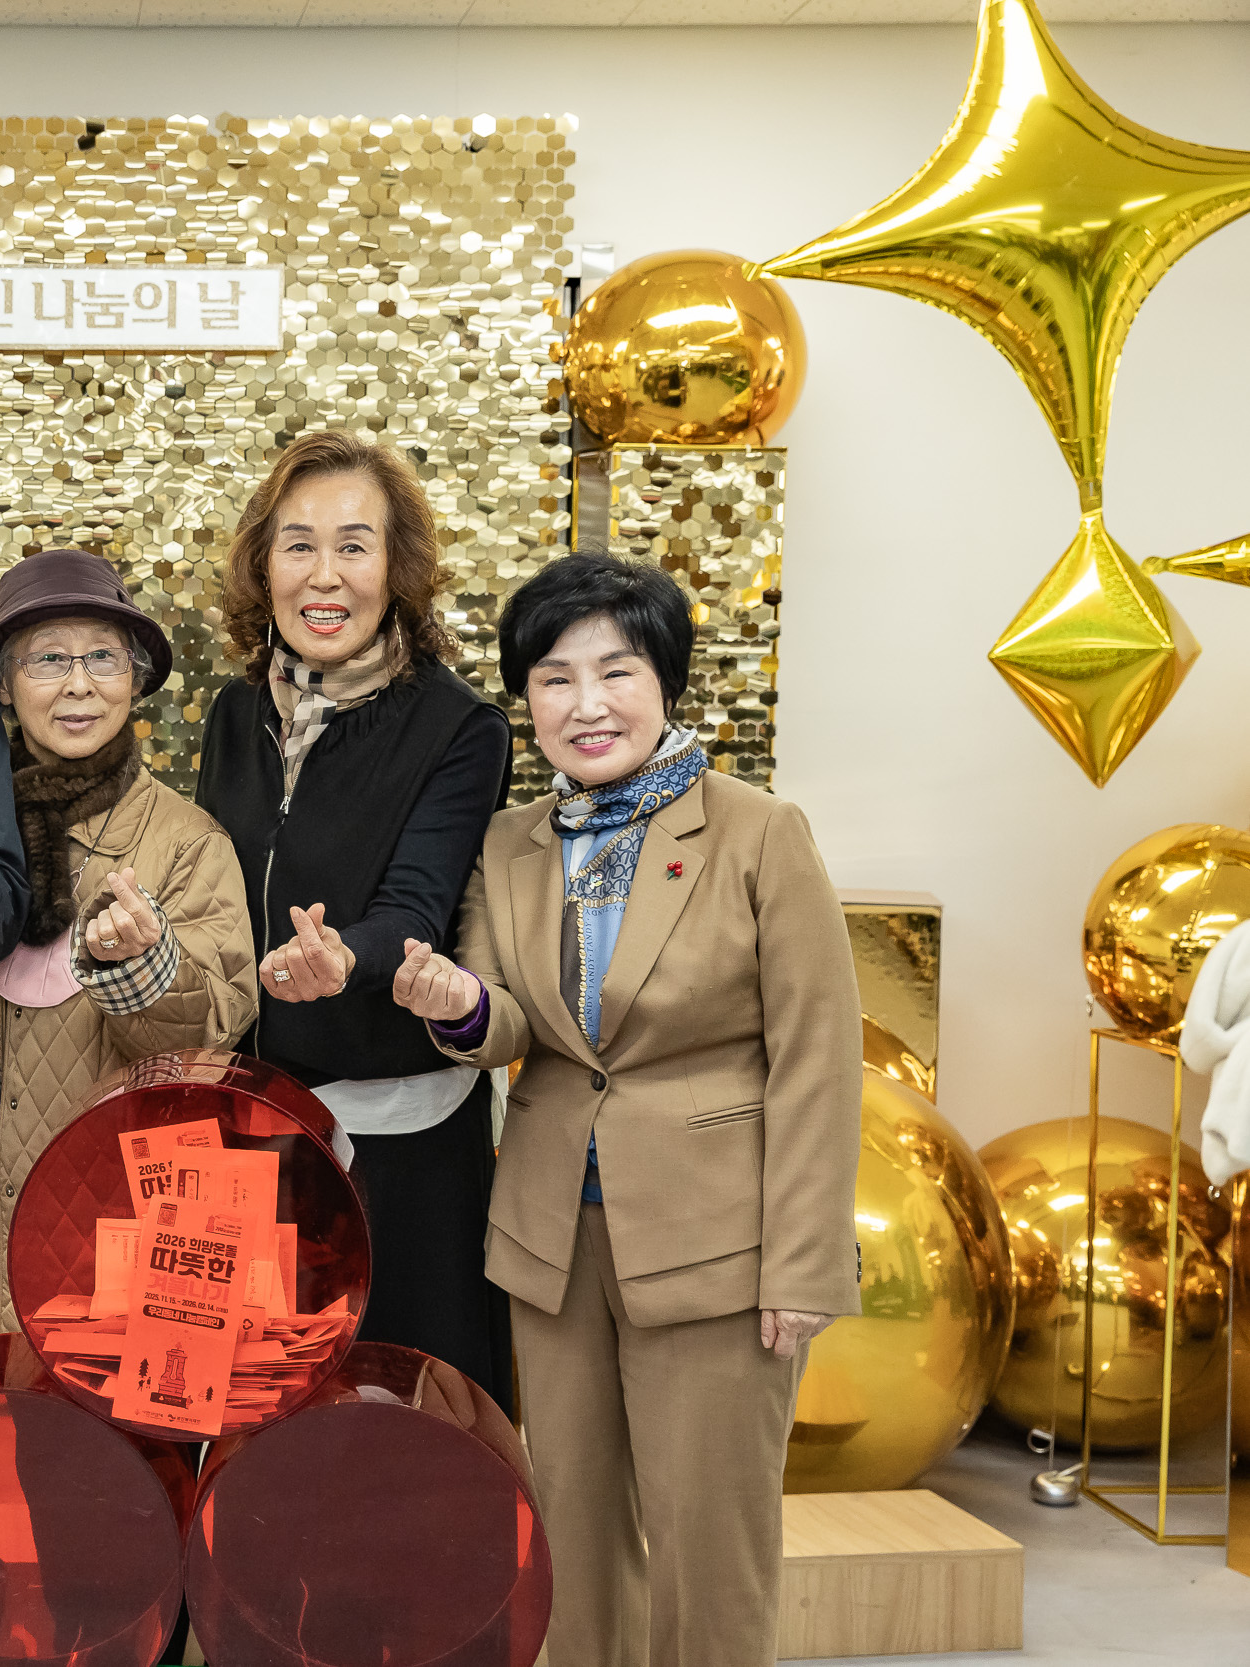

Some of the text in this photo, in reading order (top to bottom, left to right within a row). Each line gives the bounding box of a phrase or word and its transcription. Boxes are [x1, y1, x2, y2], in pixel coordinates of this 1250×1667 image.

[32, 279, 177, 330] 나눔의
[197, 280, 246, 330] 날
[138, 1162, 166, 1176] 2026
[155, 1232, 238, 1259] 2026 희망온돌
[149, 1246, 236, 1285] 따뜻한
[147, 1272, 230, 1304] 겨울나기
[148, 1306, 180, 1320] 우리동네
